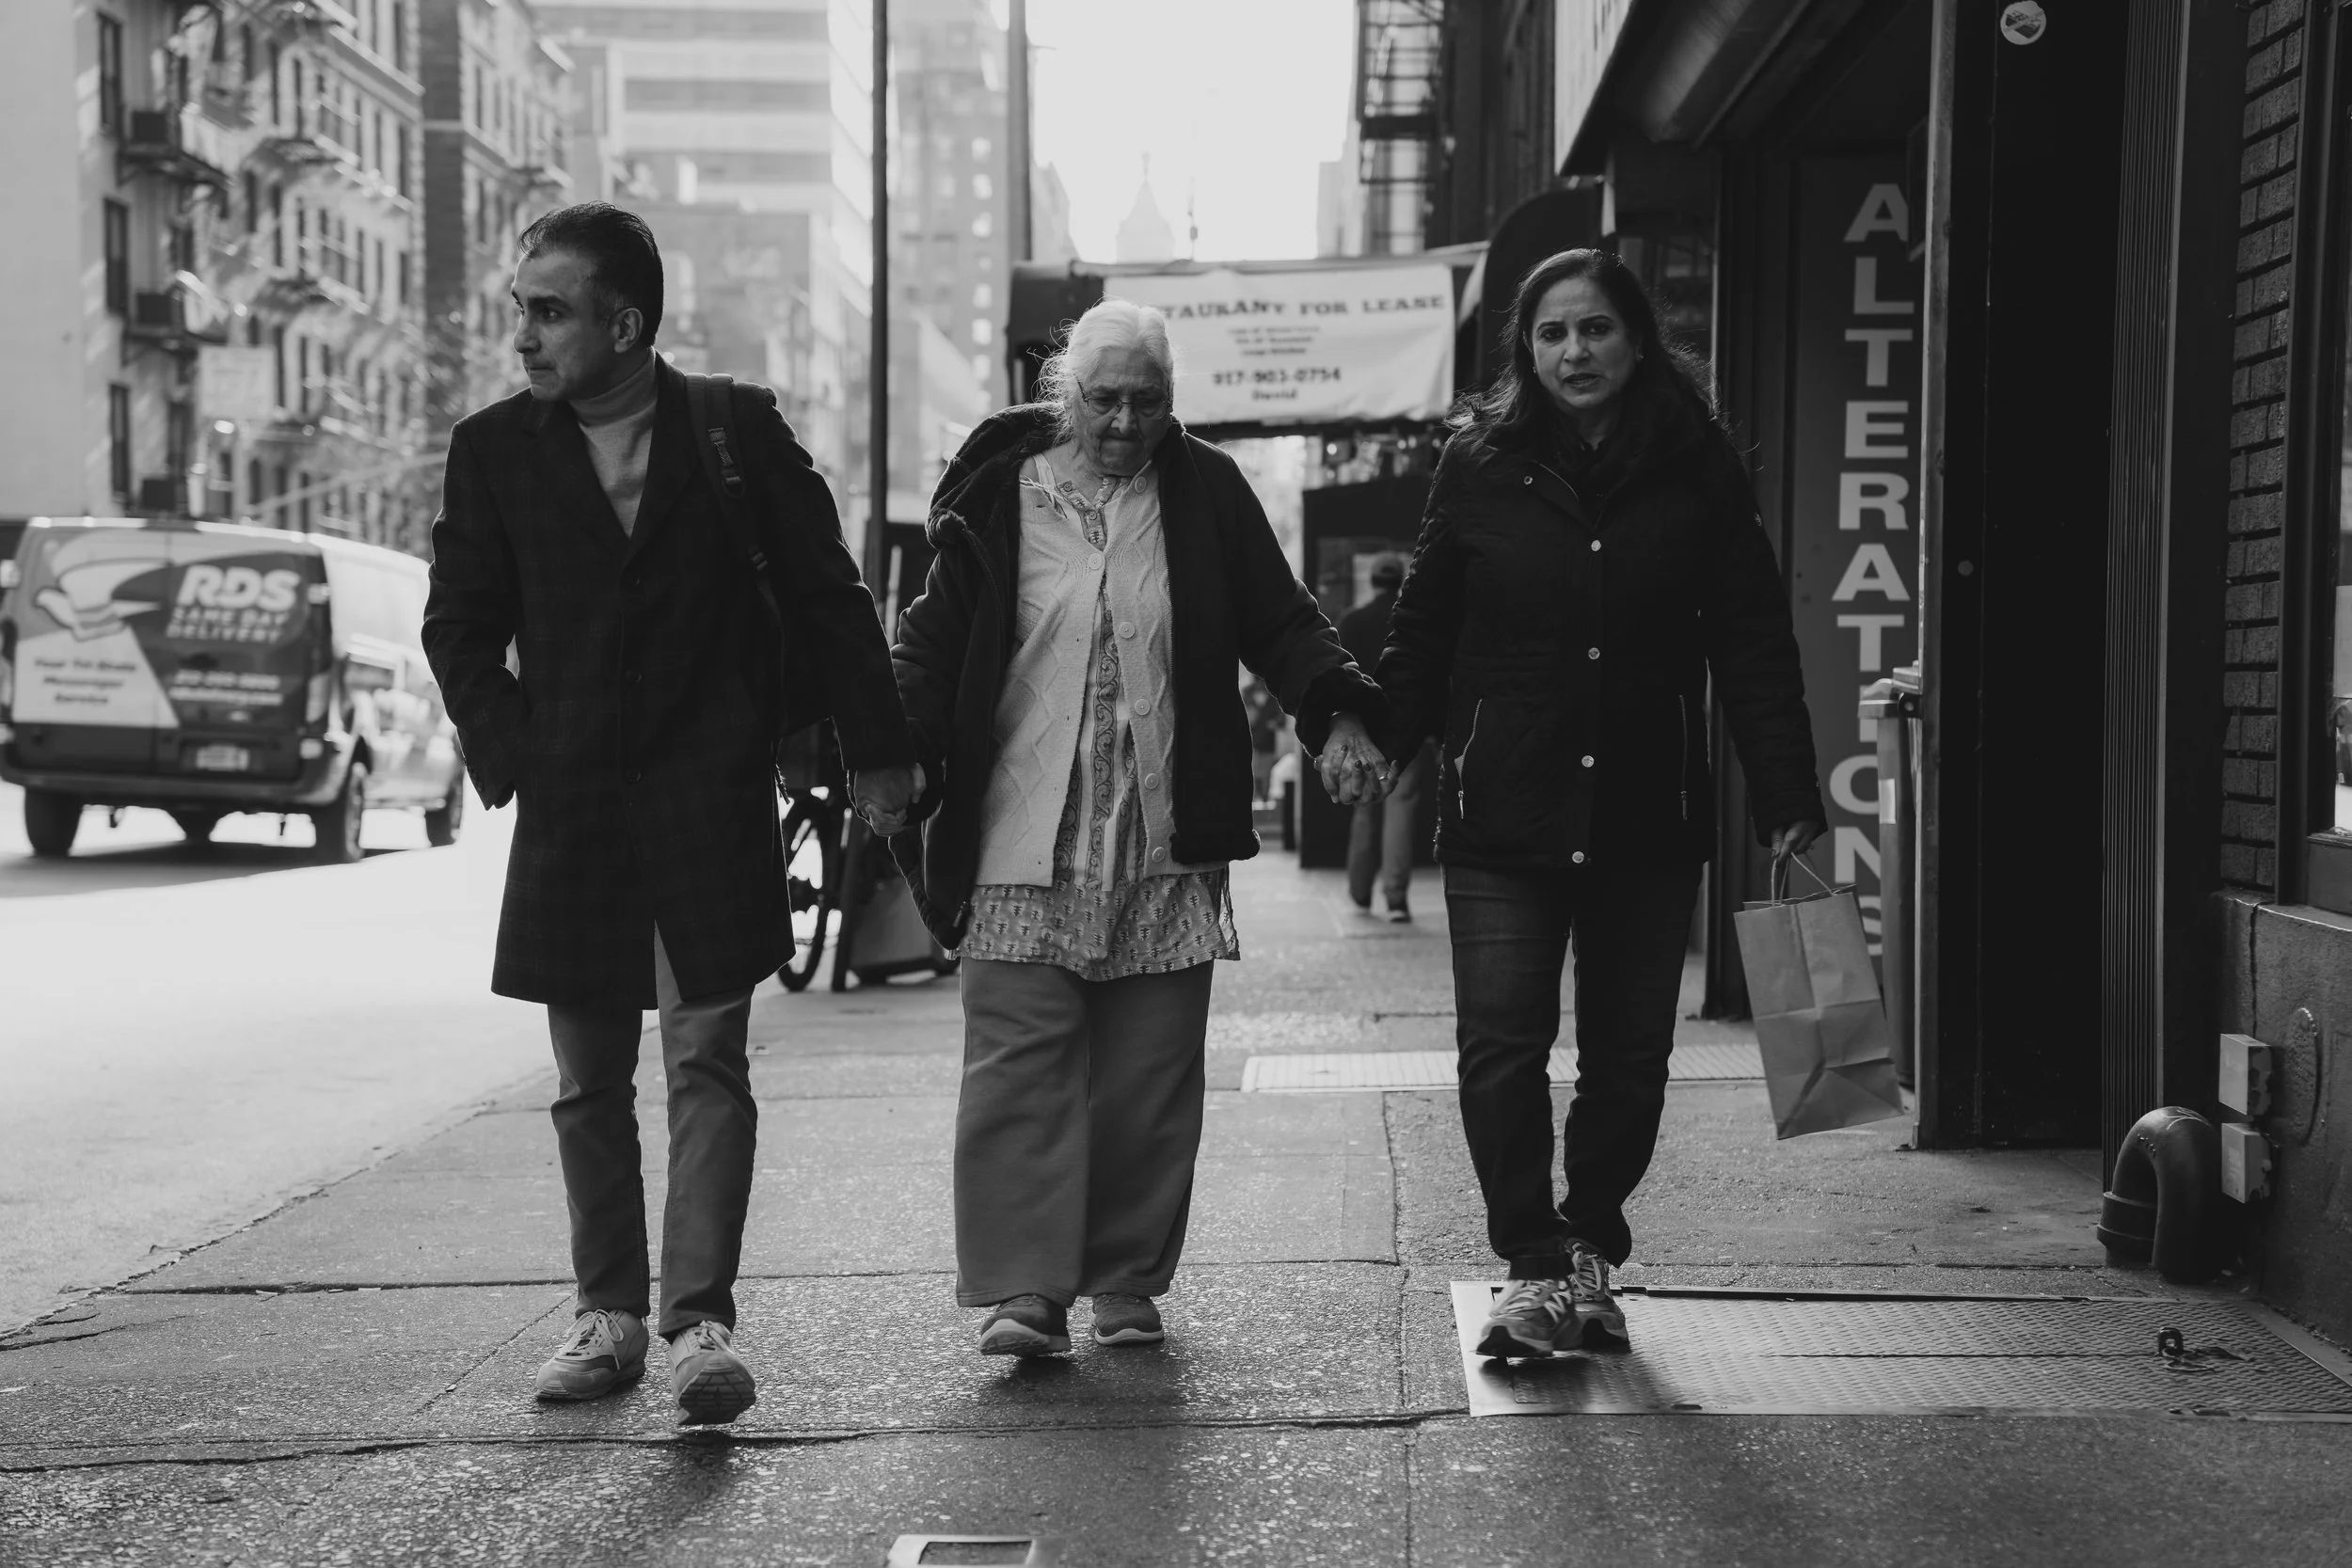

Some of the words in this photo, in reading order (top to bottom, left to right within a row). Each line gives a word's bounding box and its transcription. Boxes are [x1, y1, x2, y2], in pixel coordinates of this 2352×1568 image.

[1298, 300, 1349, 316] FOR
[1361, 294, 1446, 313] LEASE
[177, 564, 301, 611] RDS
